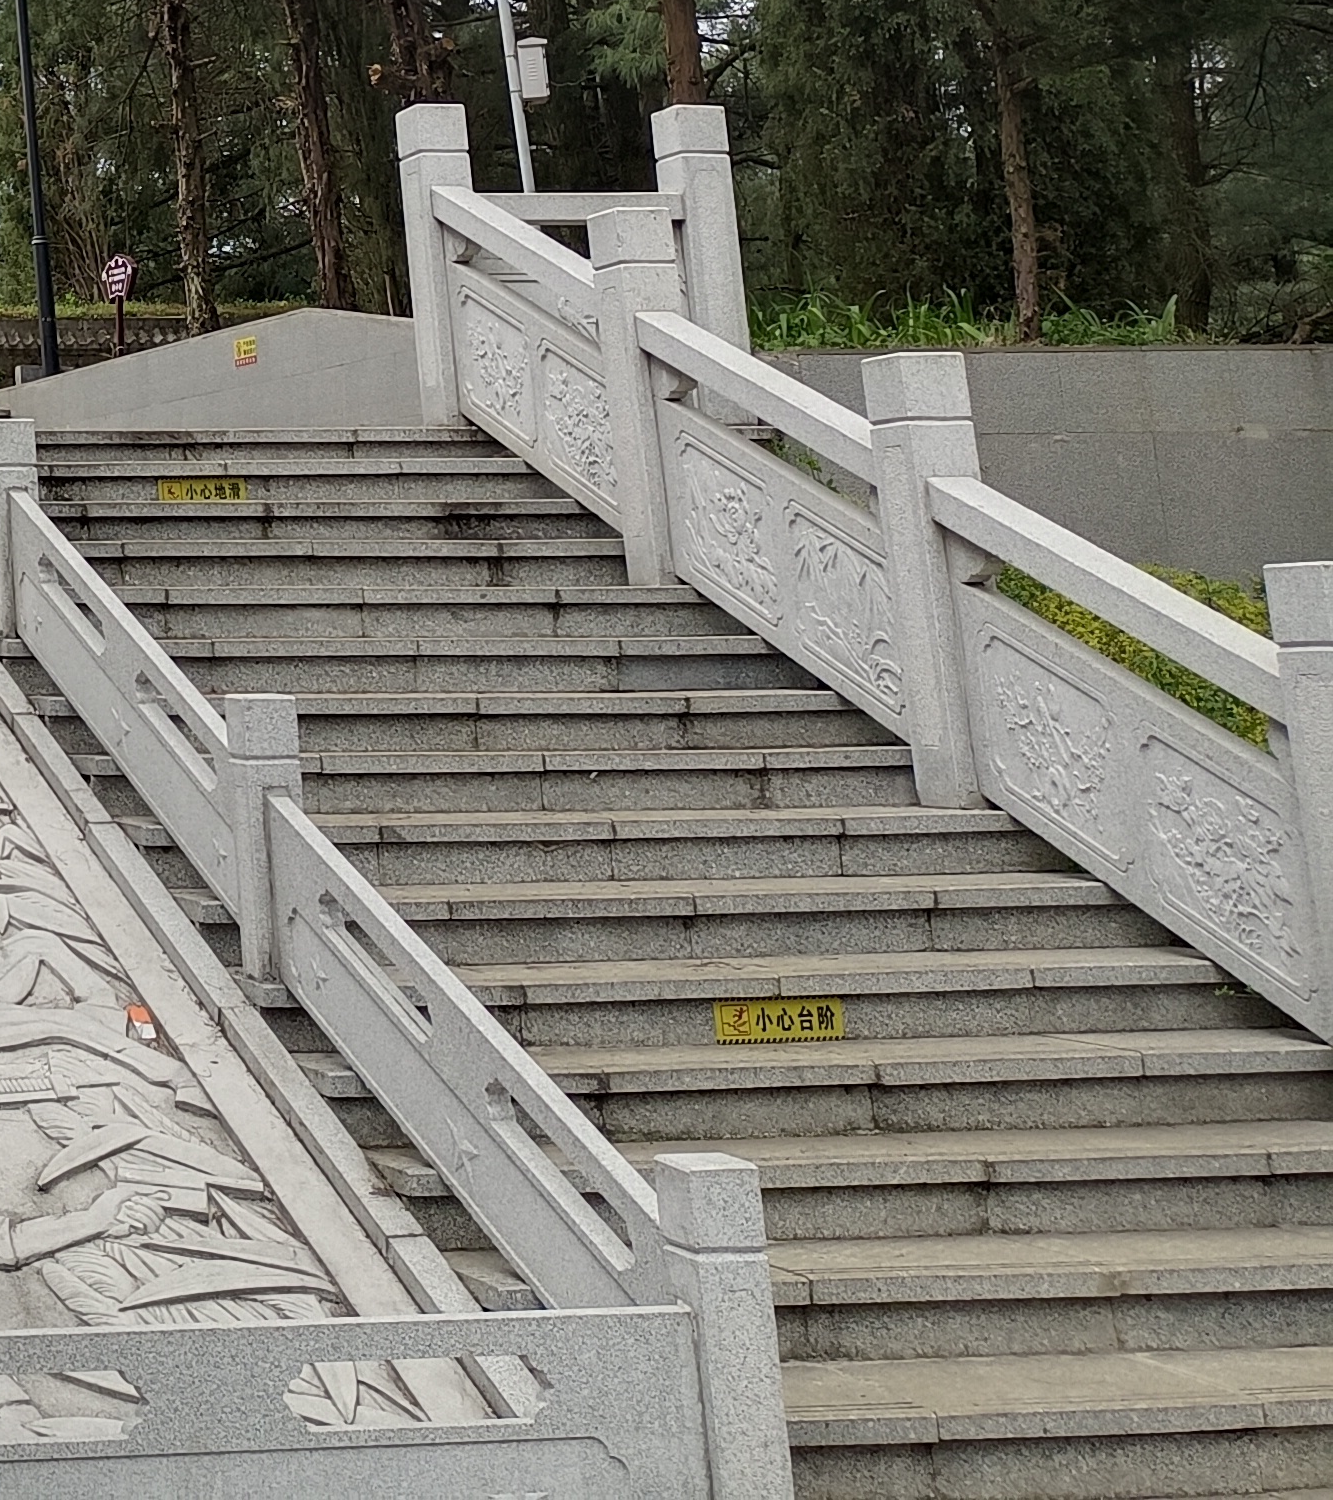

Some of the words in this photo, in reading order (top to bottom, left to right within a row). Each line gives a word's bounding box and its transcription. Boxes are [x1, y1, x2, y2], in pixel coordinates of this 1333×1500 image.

[185, 482, 241, 500] 小心地滑
[755, 1004, 836, 1033] 小心台阶
